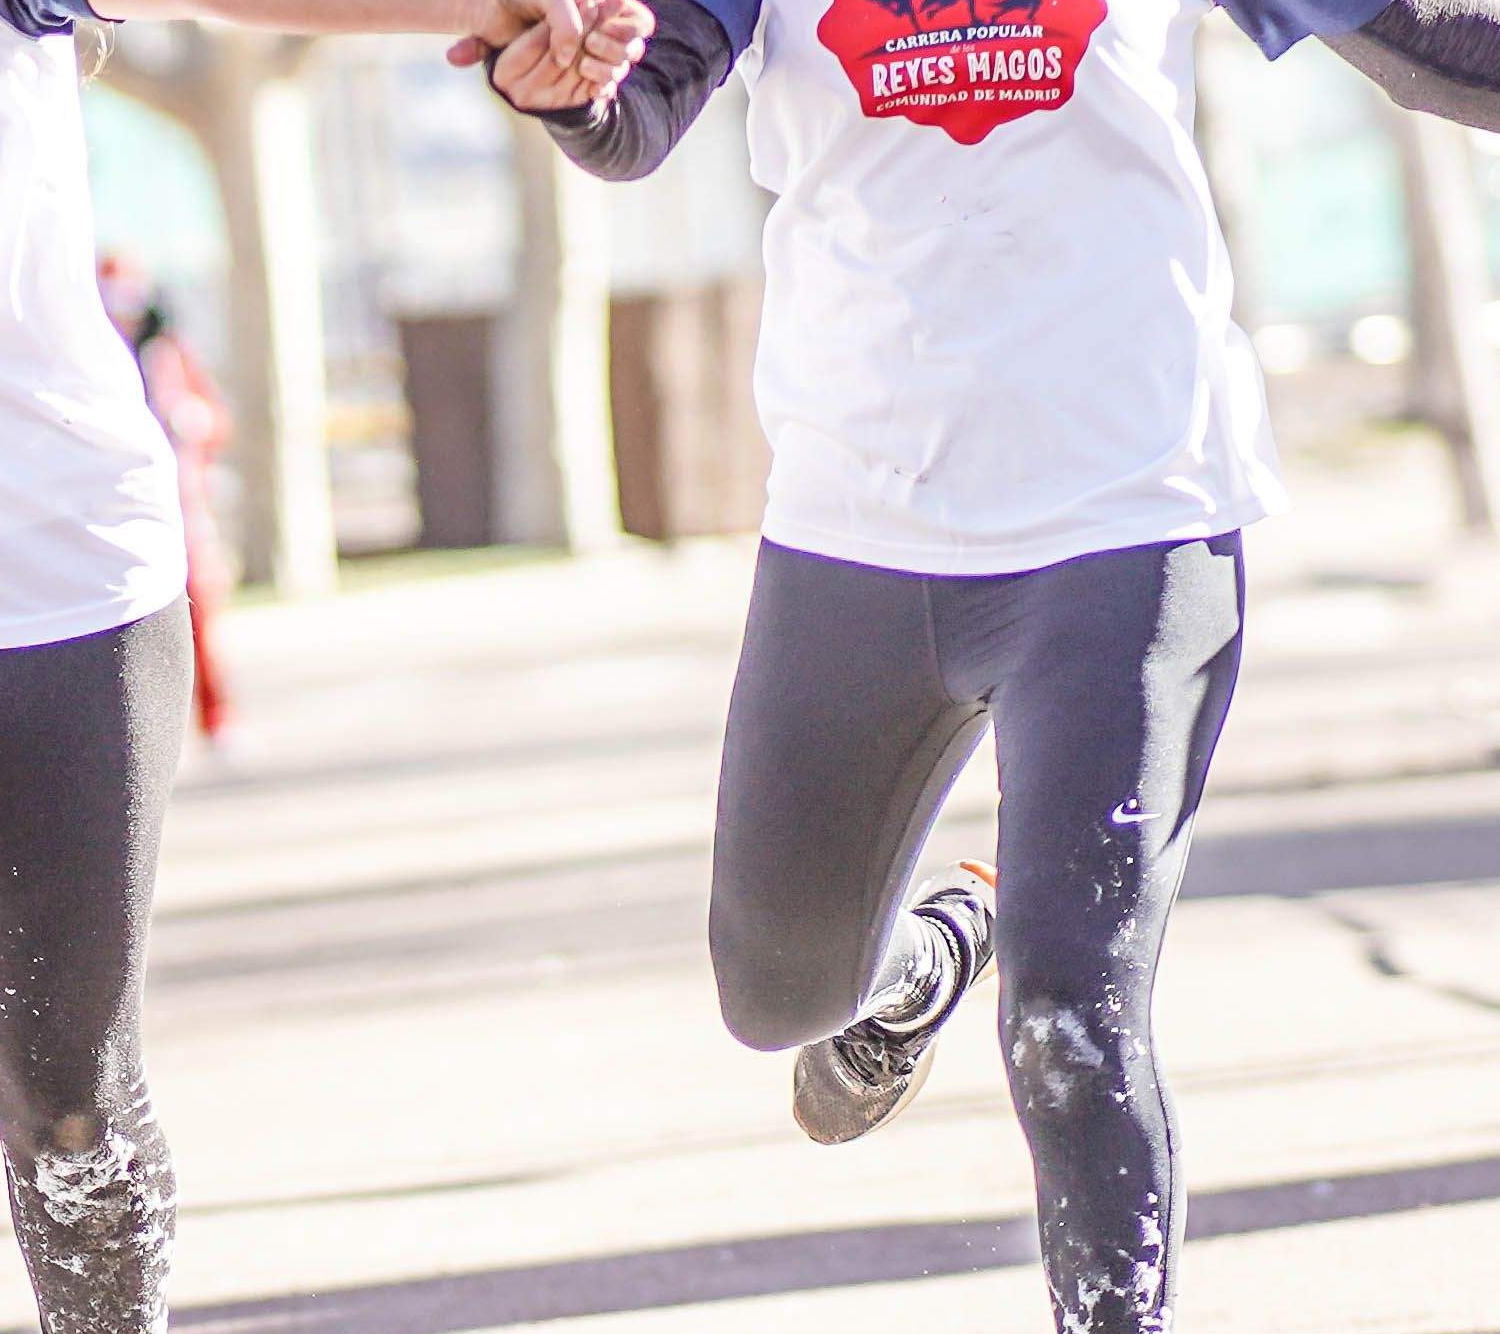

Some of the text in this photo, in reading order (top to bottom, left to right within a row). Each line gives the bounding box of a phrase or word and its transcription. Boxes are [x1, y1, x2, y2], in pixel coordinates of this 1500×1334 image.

[885, 25, 1044, 53] CARRERA POPULAR
[872, 46, 1062, 97] REYES MAGOS
[876, 88, 1061, 112] COMUNIDAD DE MADRID
